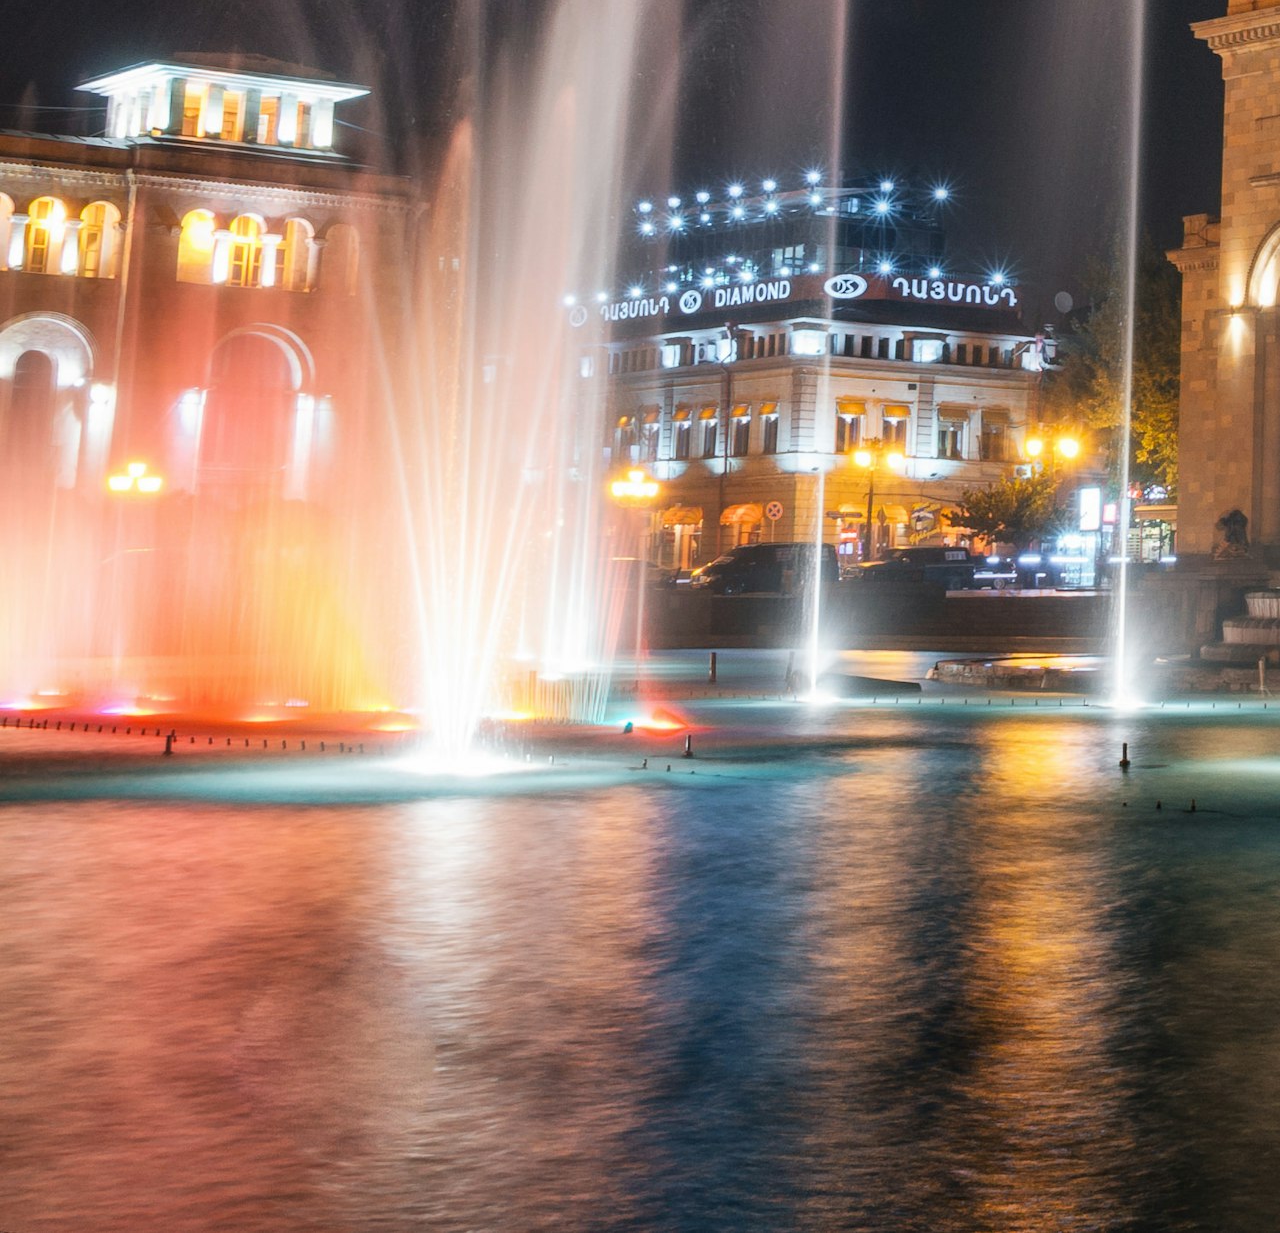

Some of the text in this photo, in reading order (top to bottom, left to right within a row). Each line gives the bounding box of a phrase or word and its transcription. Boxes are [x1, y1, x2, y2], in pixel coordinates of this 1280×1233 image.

[600, 296, 670, 322] ԴԱՅՄՈՆԴ
[715, 280, 791, 308] DIAMOND
[893, 277, 1017, 307] ԴԱՅՄՈՆԴ
